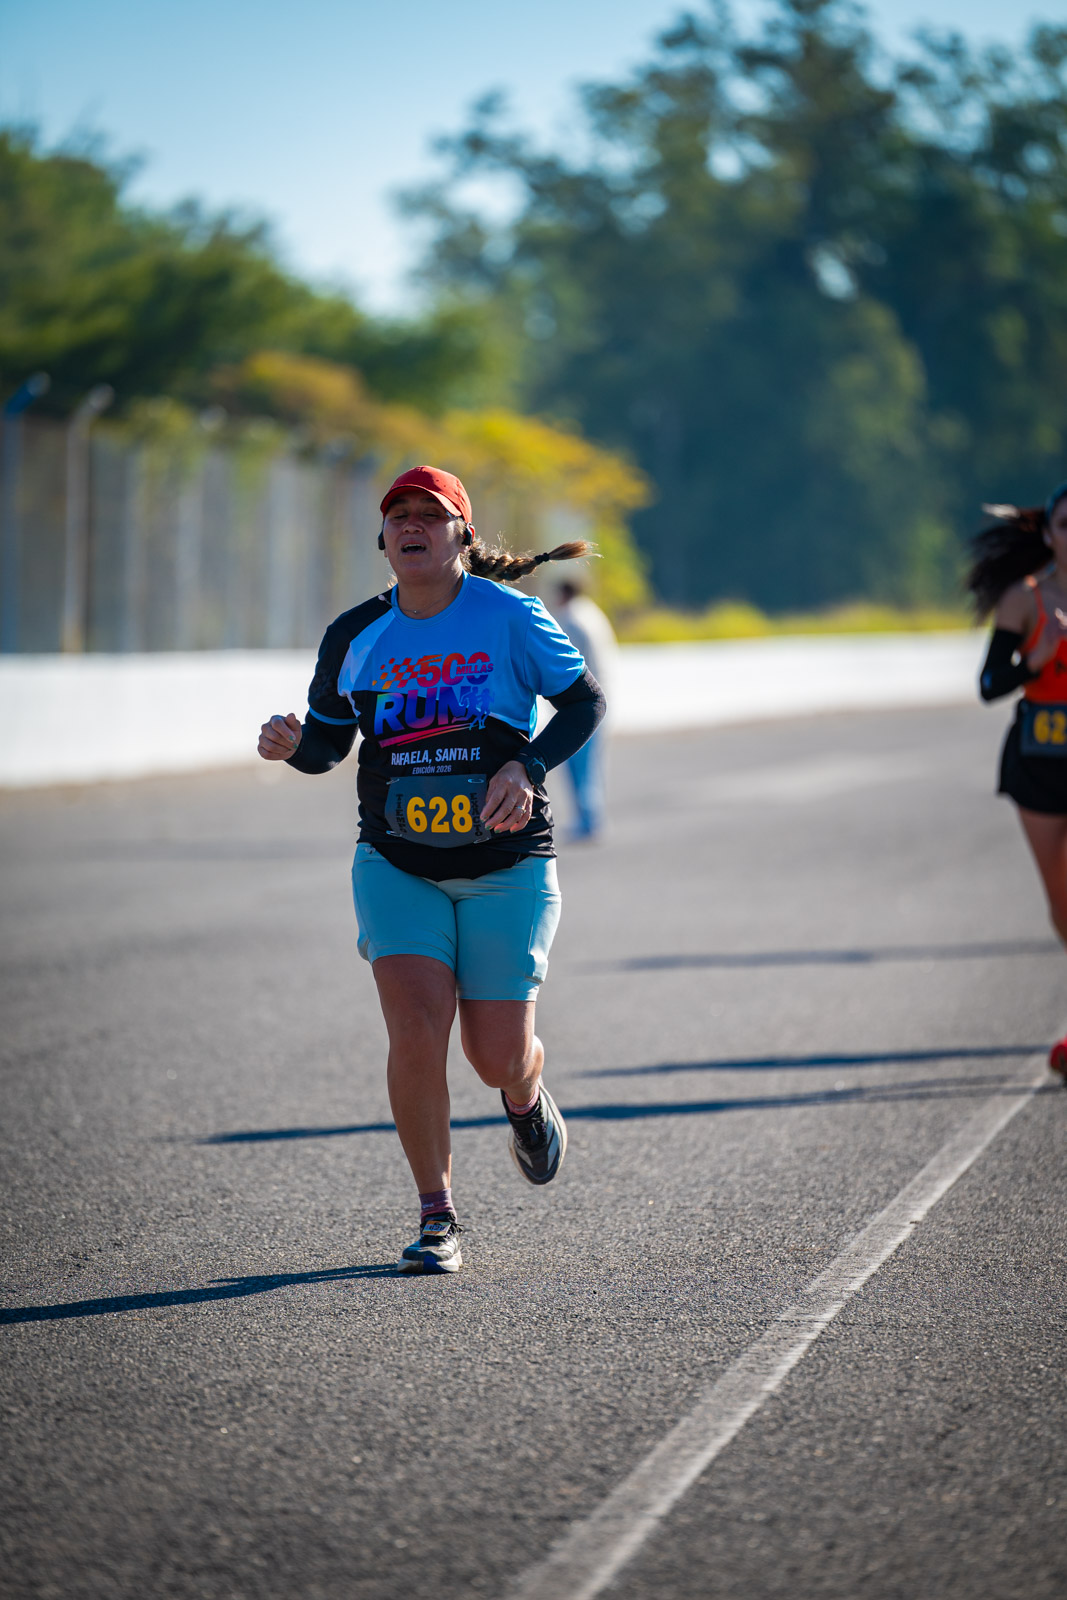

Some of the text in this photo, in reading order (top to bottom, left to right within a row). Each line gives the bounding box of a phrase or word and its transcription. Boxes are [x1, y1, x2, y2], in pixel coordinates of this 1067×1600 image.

[417, 652, 491, 688] 500
[456, 663, 494, 675] MILLAS
[374, 686, 472, 736] RUN
[391, 746, 481, 766] RAFAELA, SANTA FE
[412, 765, 435, 775] EDICIÓN
[406, 794, 473, 833] 628
[470, 792, 483, 837] EXACTO
